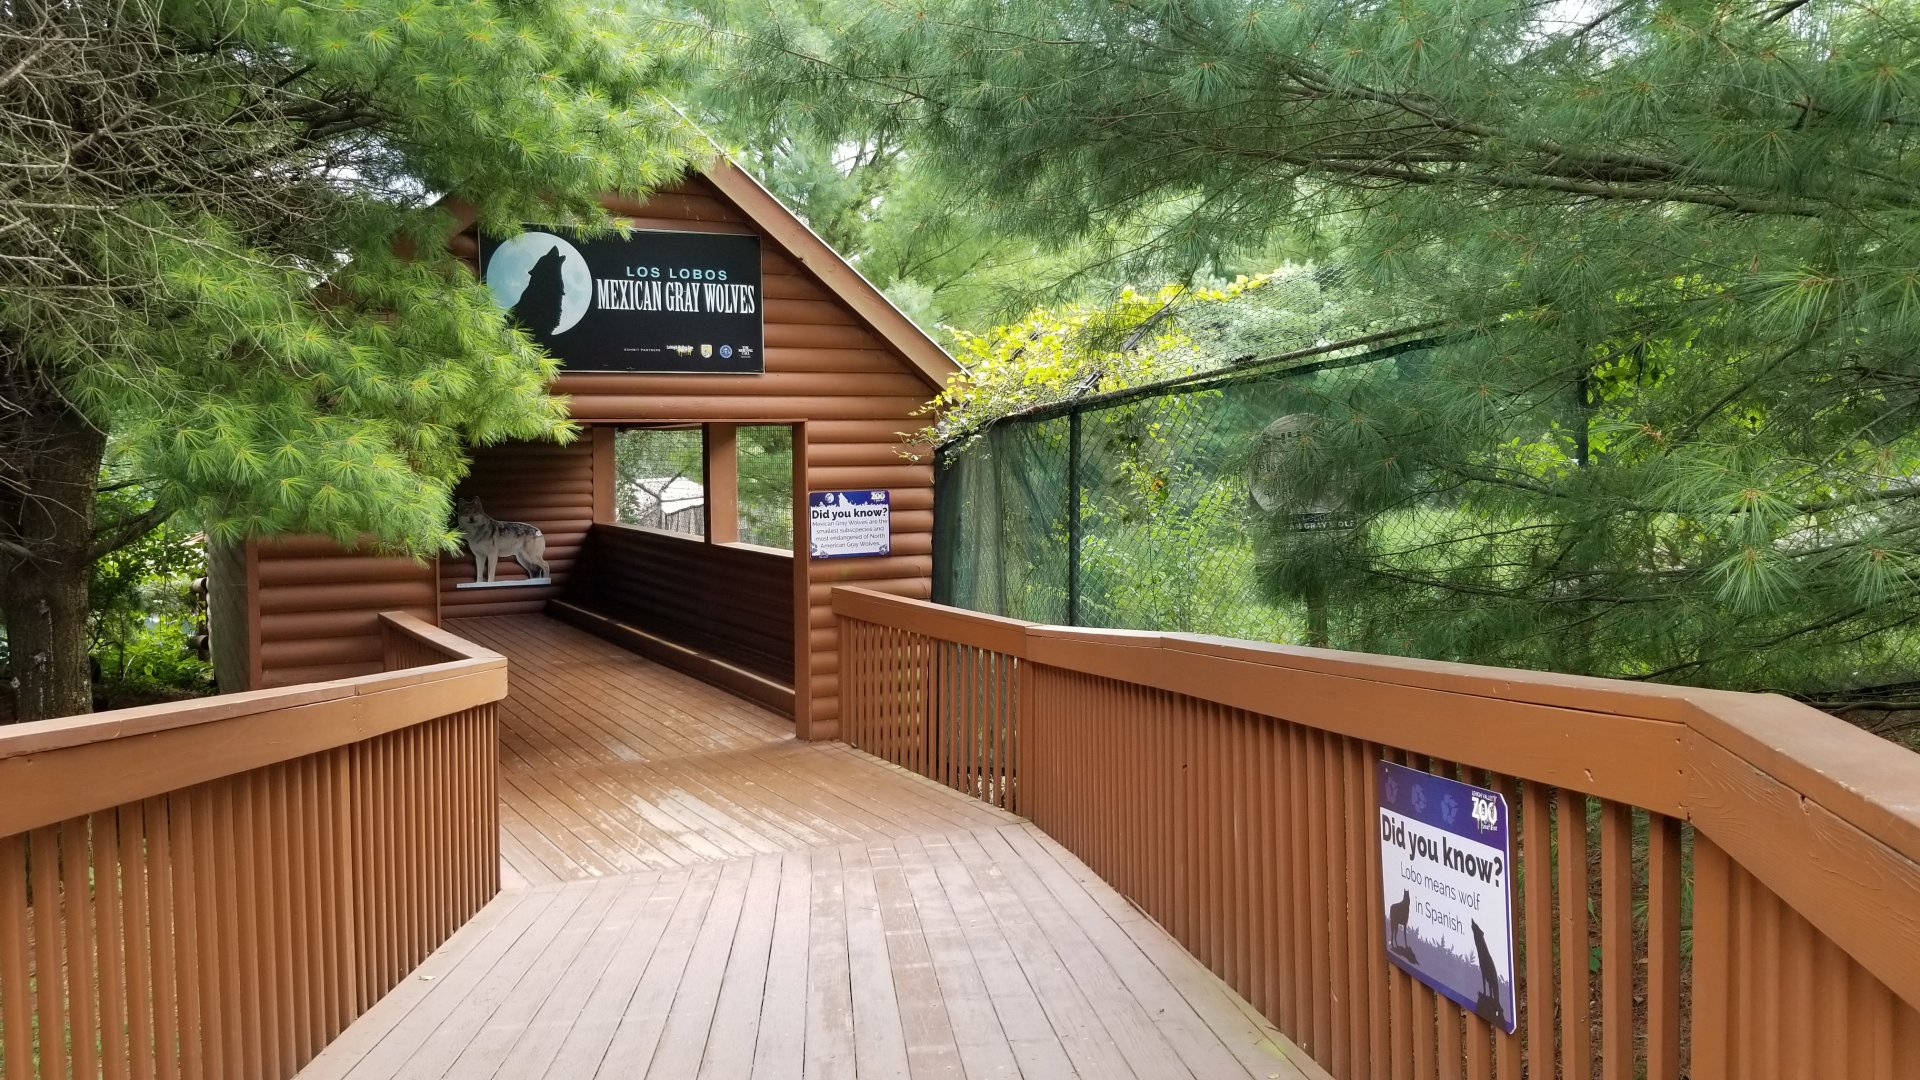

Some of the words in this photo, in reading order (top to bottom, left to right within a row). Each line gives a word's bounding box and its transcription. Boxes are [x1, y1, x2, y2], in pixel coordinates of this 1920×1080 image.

[626, 266, 661, 278] LOS
[669, 268, 728, 281] LOBOS
[596, 279, 662, 311] MEXICAN
[665, 281, 701, 313] GRAY
[703, 283, 755, 314] WOLVES
[812, 509, 830, 519] Did
[831, 510, 852, 521] you
[853, 507, 888, 518] know?
[829, 533, 863, 541] endangered
[1471, 796, 1497, 826] ZOO
[1381, 814, 1405, 849] Did
[1408, 831, 1439, 861] you
[1443, 837, 1503, 888] know?
[1400, 861, 1423, 885] Lobo
[1424, 875, 1457, 901] means
[1457, 891, 1481, 911] wolf
[1415, 896, 1424, 914] in
[1425, 902, 1466, 936] Spanish.
